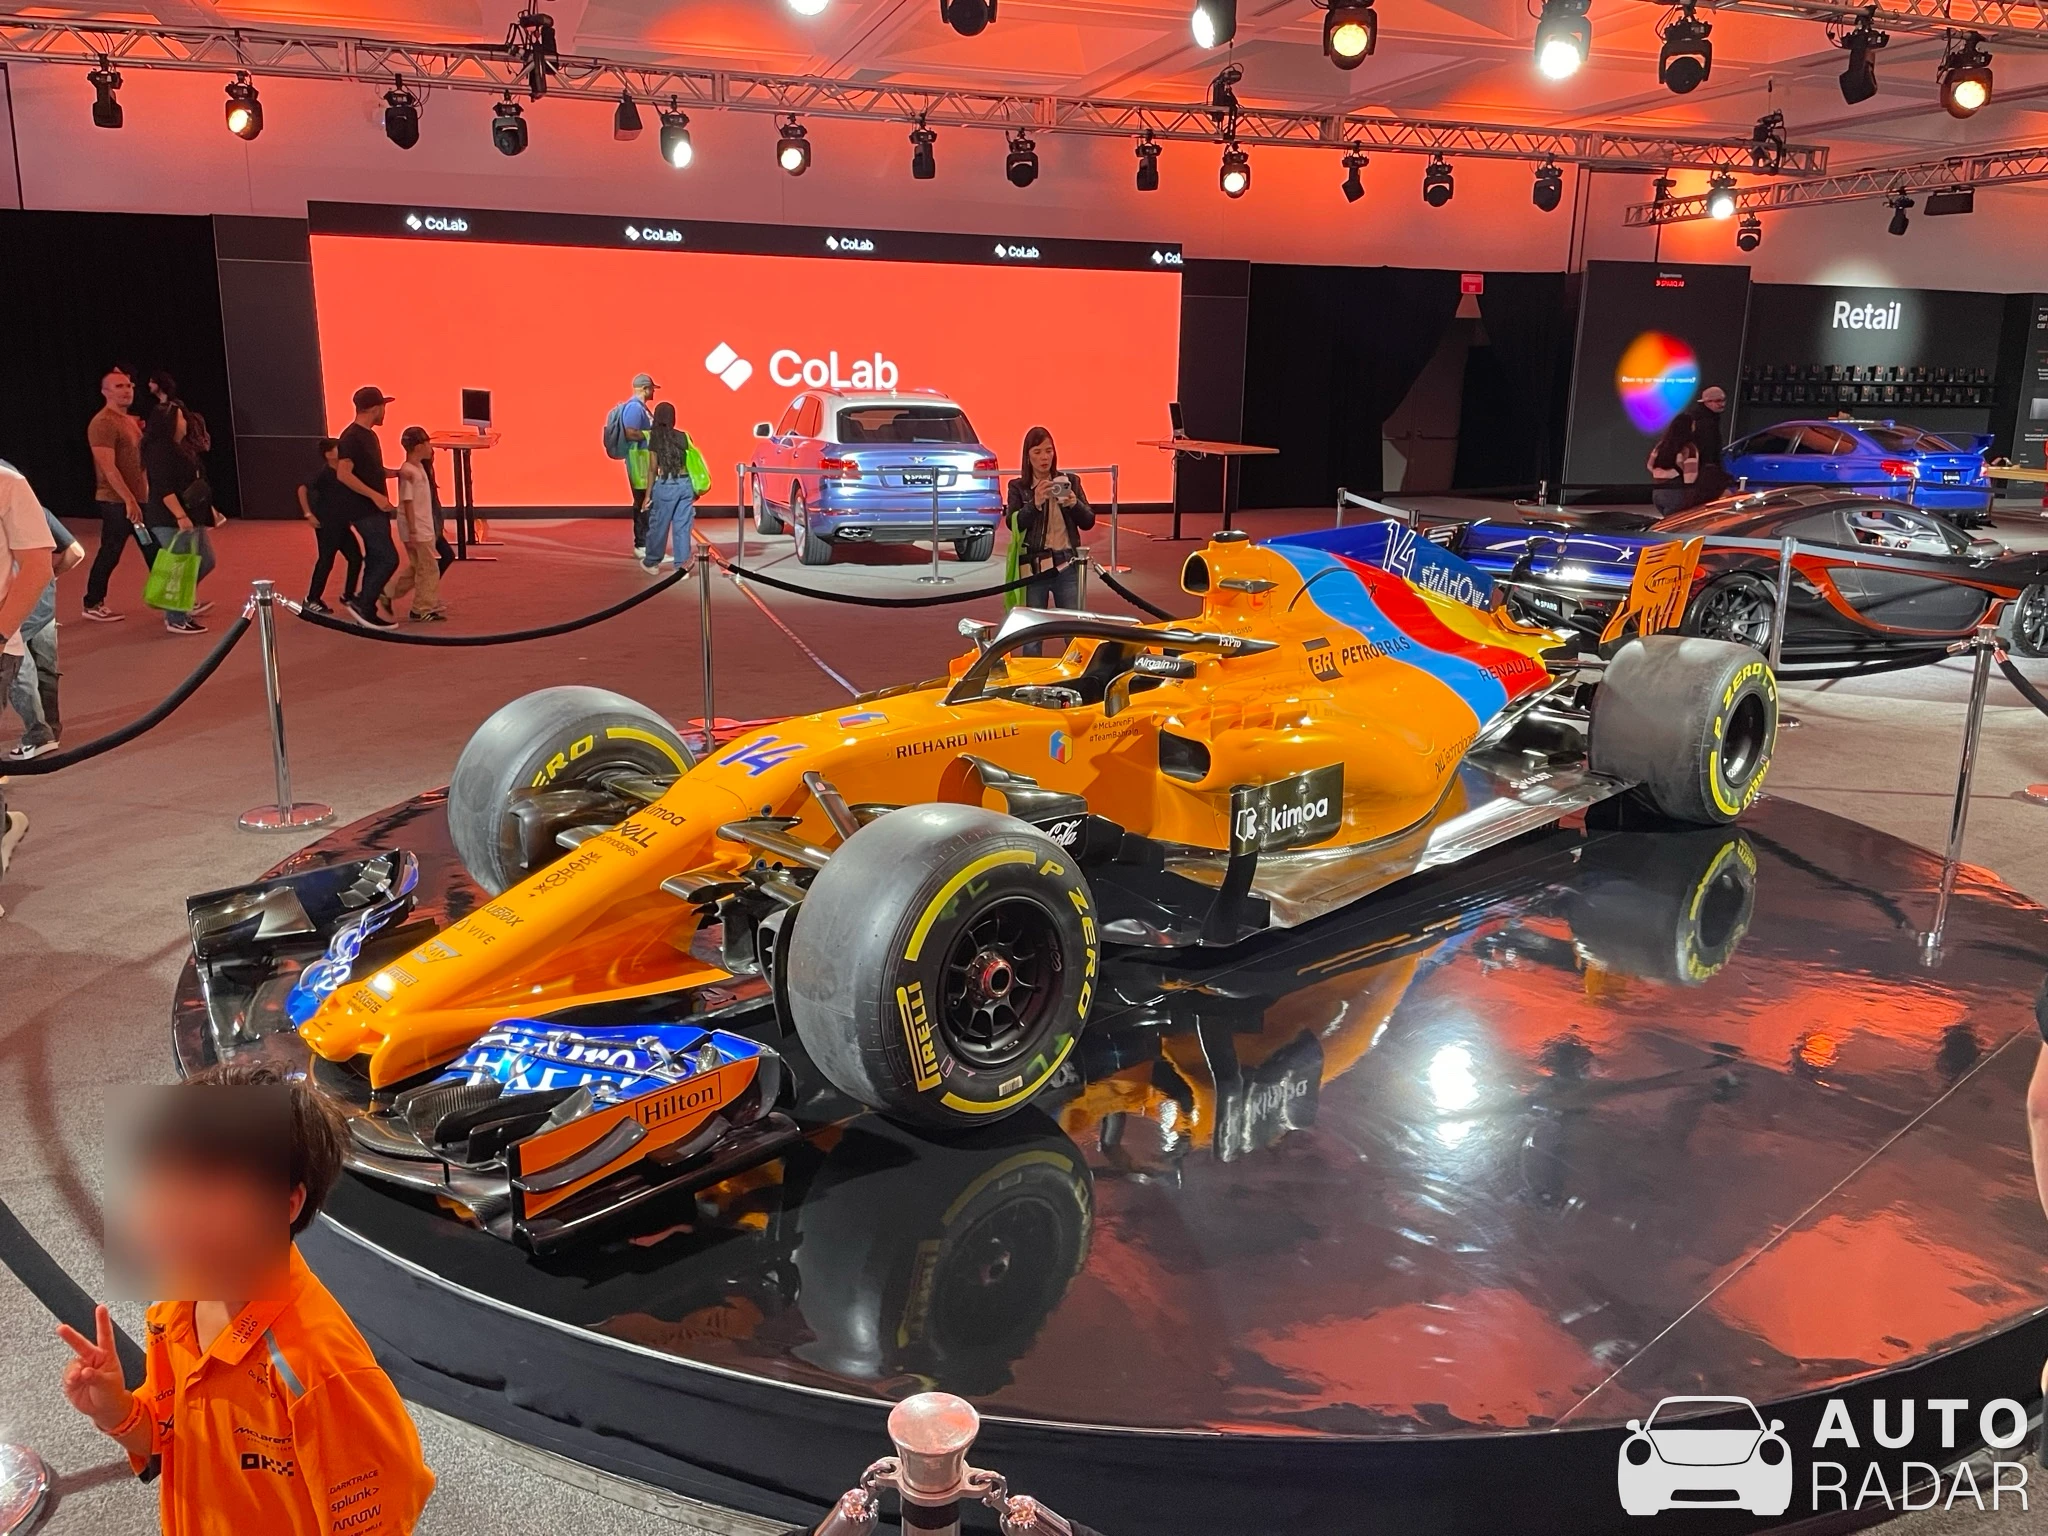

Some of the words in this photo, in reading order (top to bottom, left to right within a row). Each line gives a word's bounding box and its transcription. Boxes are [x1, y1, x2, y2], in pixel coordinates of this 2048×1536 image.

[425, 217, 468, 232] CoLab
[642, 227, 682, 242] CoLab
[840, 238, 874, 251] CoLab
[1008, 245, 1039, 258] CoLab
[1832, 300, 1901, 329] Retail
[769, 349, 899, 389] CoLab
[1383, 519, 1417, 580] 14
[1341, 636, 1411, 666] PETROBRAS
[1478, 656, 1536, 682] RENAULT
[1723, 662, 1763, 711] ZERO
[717, 734, 809, 777] 14
[896, 733, 968, 759] RICHARD
[973, 724, 1020, 744] MILLE
[531, 734, 594, 788] ERO
[1271, 797, 1329, 833] kimoa
[467, 925, 496, 945] VIVE
[1039, 859, 1065, 877] P
[1068, 886, 1097, 1020] ZERO
[896, 981, 943, 1093] PIRELLI
[643, 1086, 714, 1125] Hilton
[329, 1469, 379, 1494] DARKTRACE
